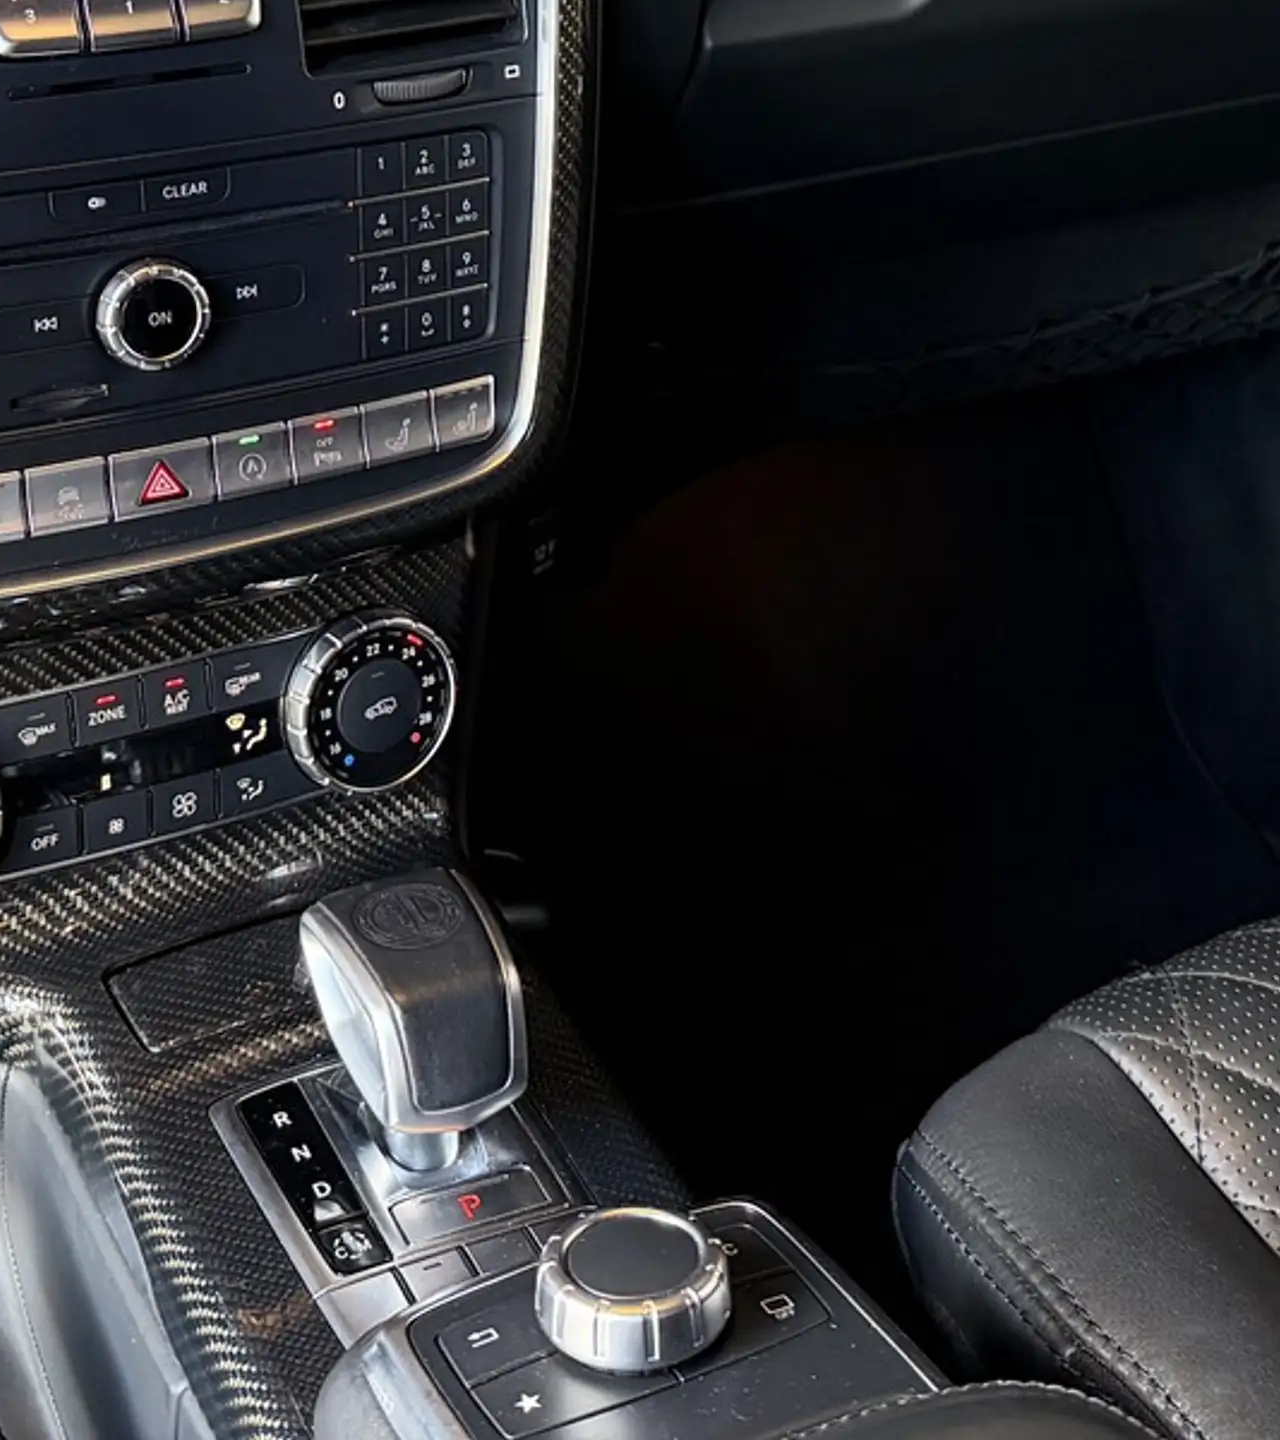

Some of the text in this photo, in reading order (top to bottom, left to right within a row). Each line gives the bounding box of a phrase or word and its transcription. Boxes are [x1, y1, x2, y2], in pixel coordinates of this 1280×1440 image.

[23, 9, 37, 24] 3
[125, 0, 134, 15] 1
[419, 149, 429, 165] 2
[462, 142, 471, 157] 3
[378, 156, 385, 171] 1
[162, 180, 209, 200] CLEAR
[377, 212, 388, 227] 4
[378, 265, 389, 282] 7
[148, 310, 173, 328] ON
[164, 688, 191, 710] A/C
[87, 704, 128, 728] ZONE
[30, 832, 61, 852] OFF
[272, 1110, 293, 1129] R
[290, 1143, 313, 1164] N
[311, 1180, 332, 1199] D
[457, 1194, 482, 1223] P
